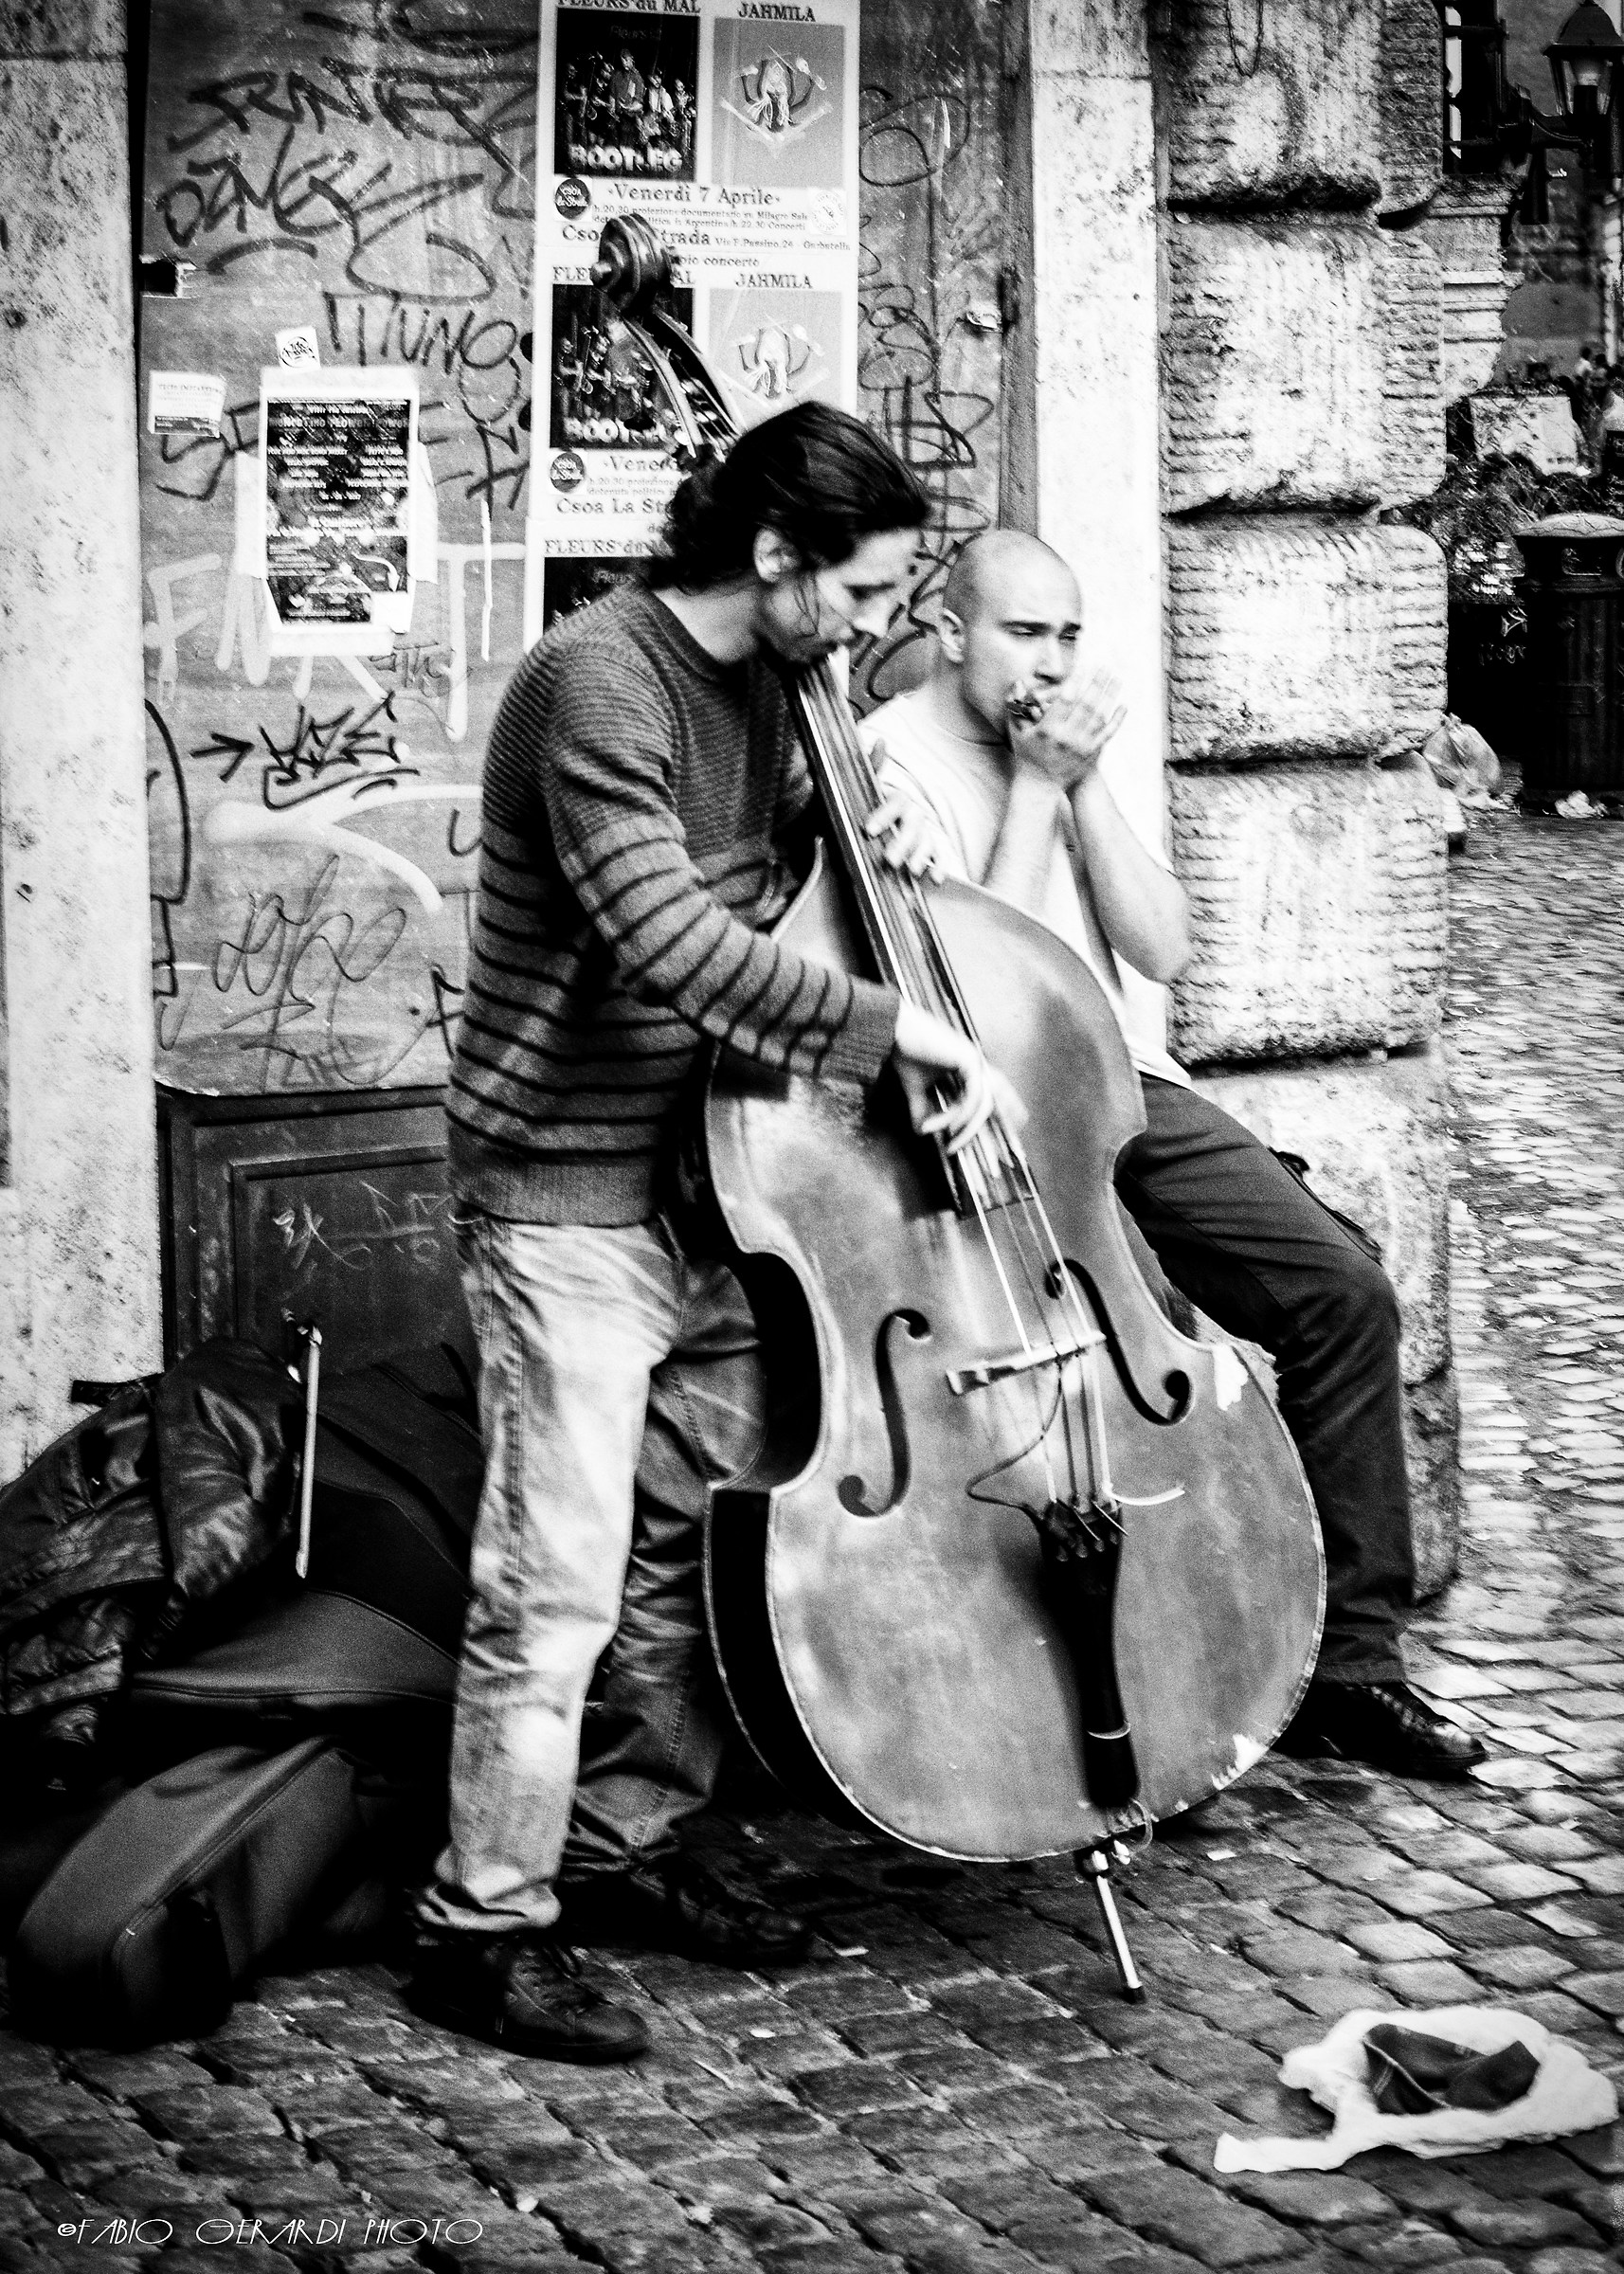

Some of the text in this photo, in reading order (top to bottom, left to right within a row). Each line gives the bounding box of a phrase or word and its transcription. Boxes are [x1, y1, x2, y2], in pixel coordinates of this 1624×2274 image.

[664, 0, 701, 13] MAL
[738, 4, 817, 23] JAHMILA
[699, 186, 711, 203] 7
[562, 224, 599, 242] Cso
[660, 229, 711, 245] trada
[703, 256, 760, 266] concerto
[671, 267, 696, 284] AL
[735, 273, 813, 289] JAHMILA
[557, 497, 604, 514] Csoa
[612, 497, 635, 514] La
[544, 538, 617, 554] FLEURS
